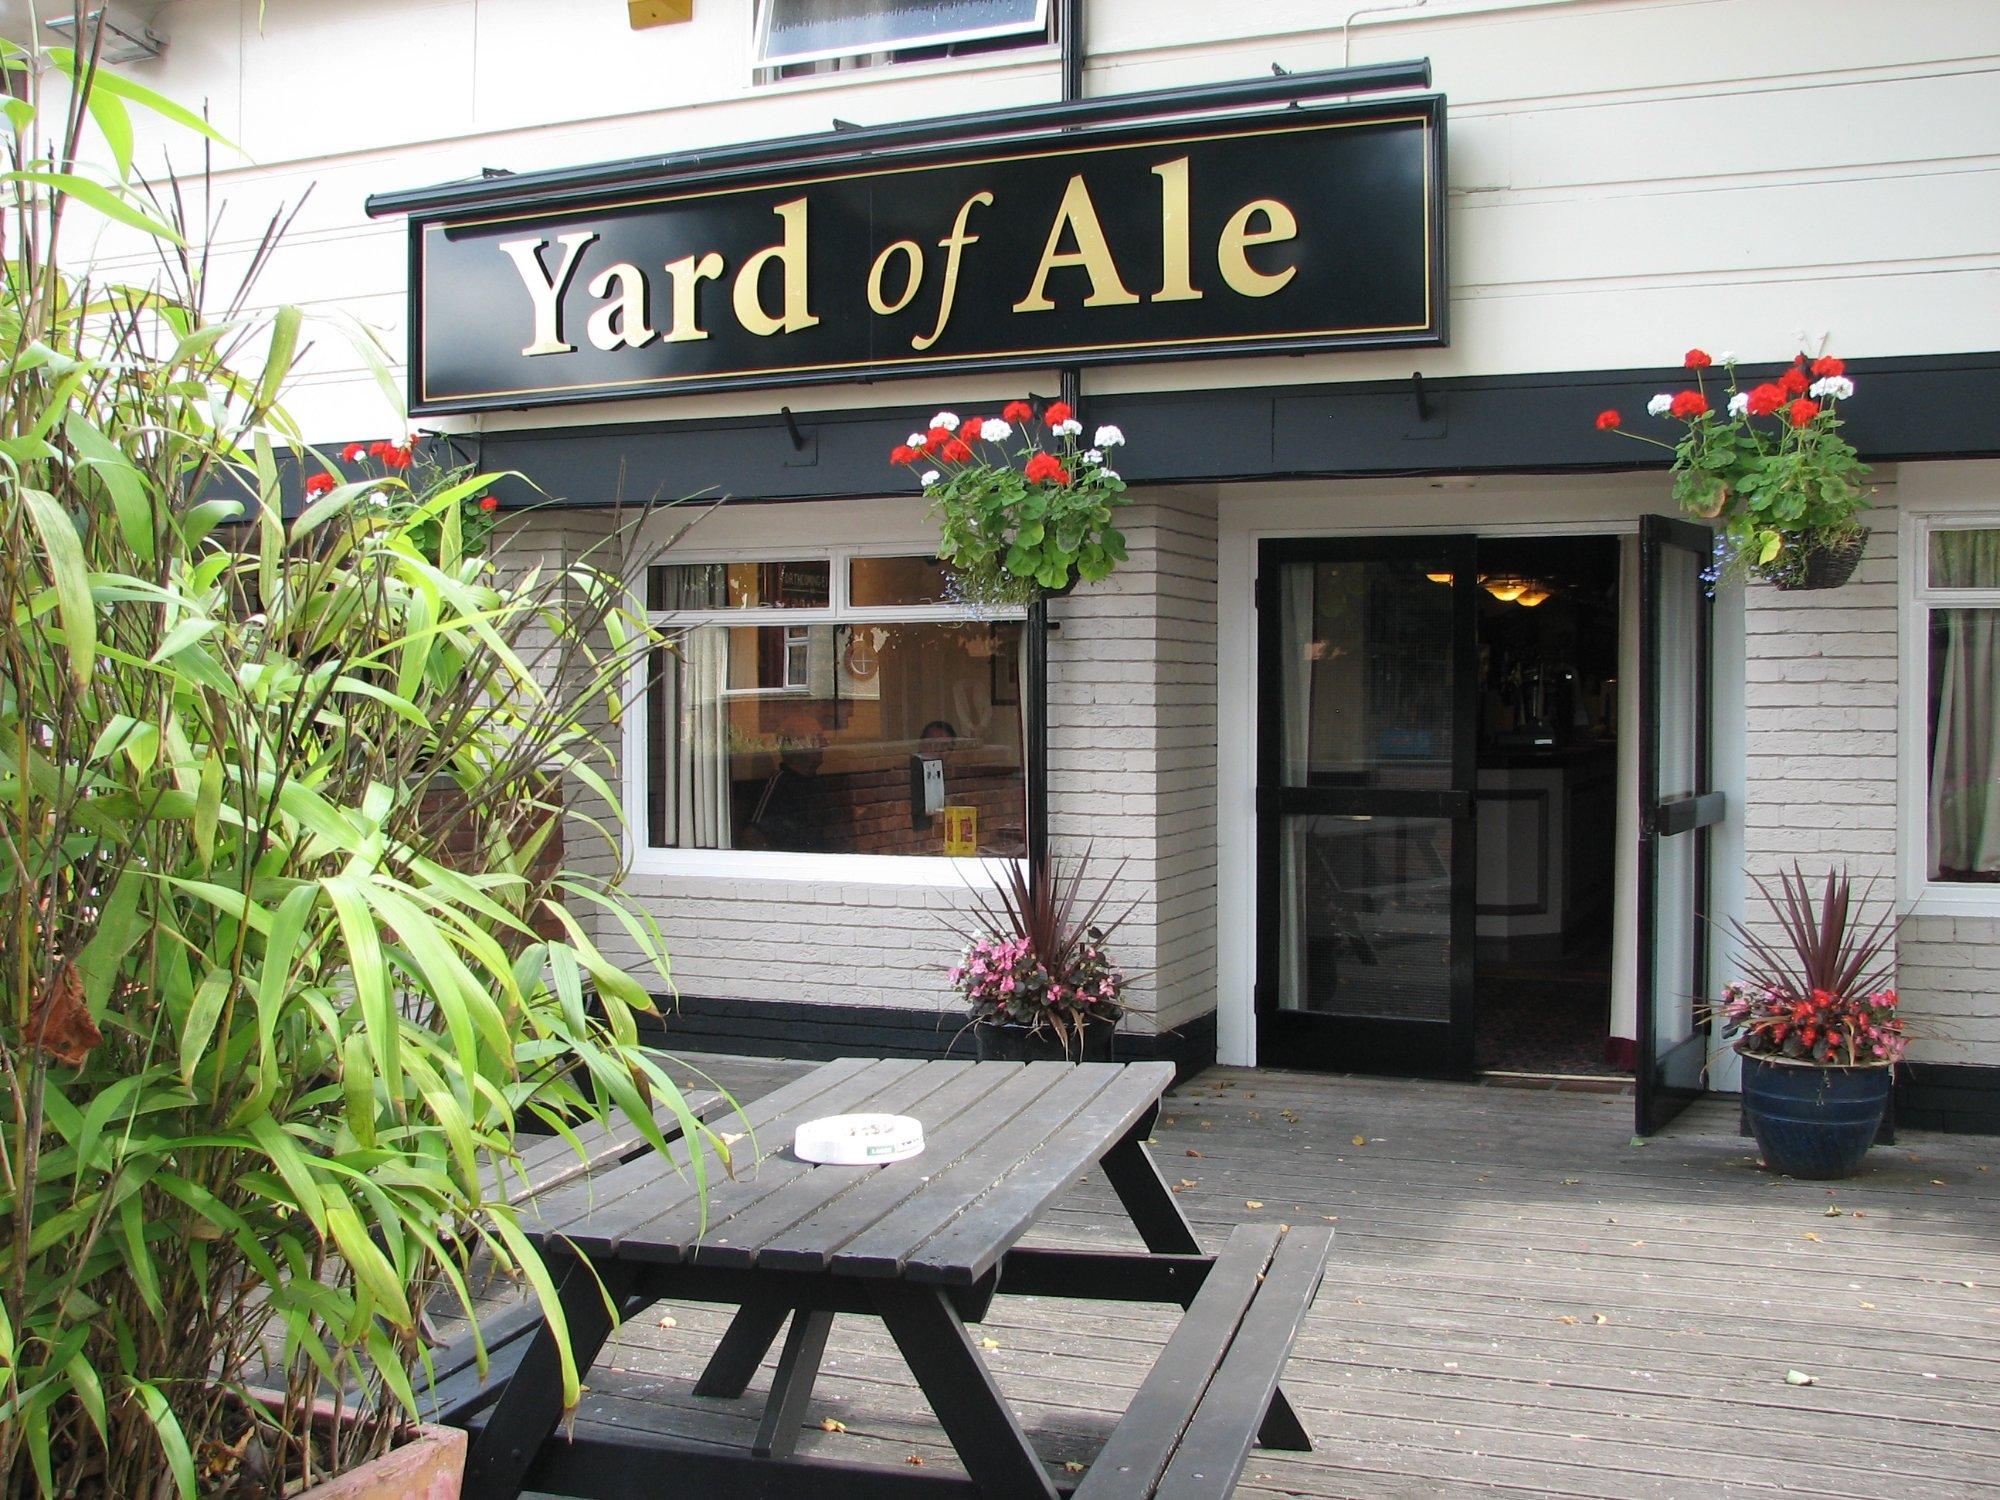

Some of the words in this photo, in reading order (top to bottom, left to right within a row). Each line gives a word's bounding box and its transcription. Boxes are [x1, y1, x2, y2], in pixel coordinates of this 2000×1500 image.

[498, 198, 820, 358] Yard
[867, 191, 995, 352] of
[1012, 156, 1297, 313] Ale
